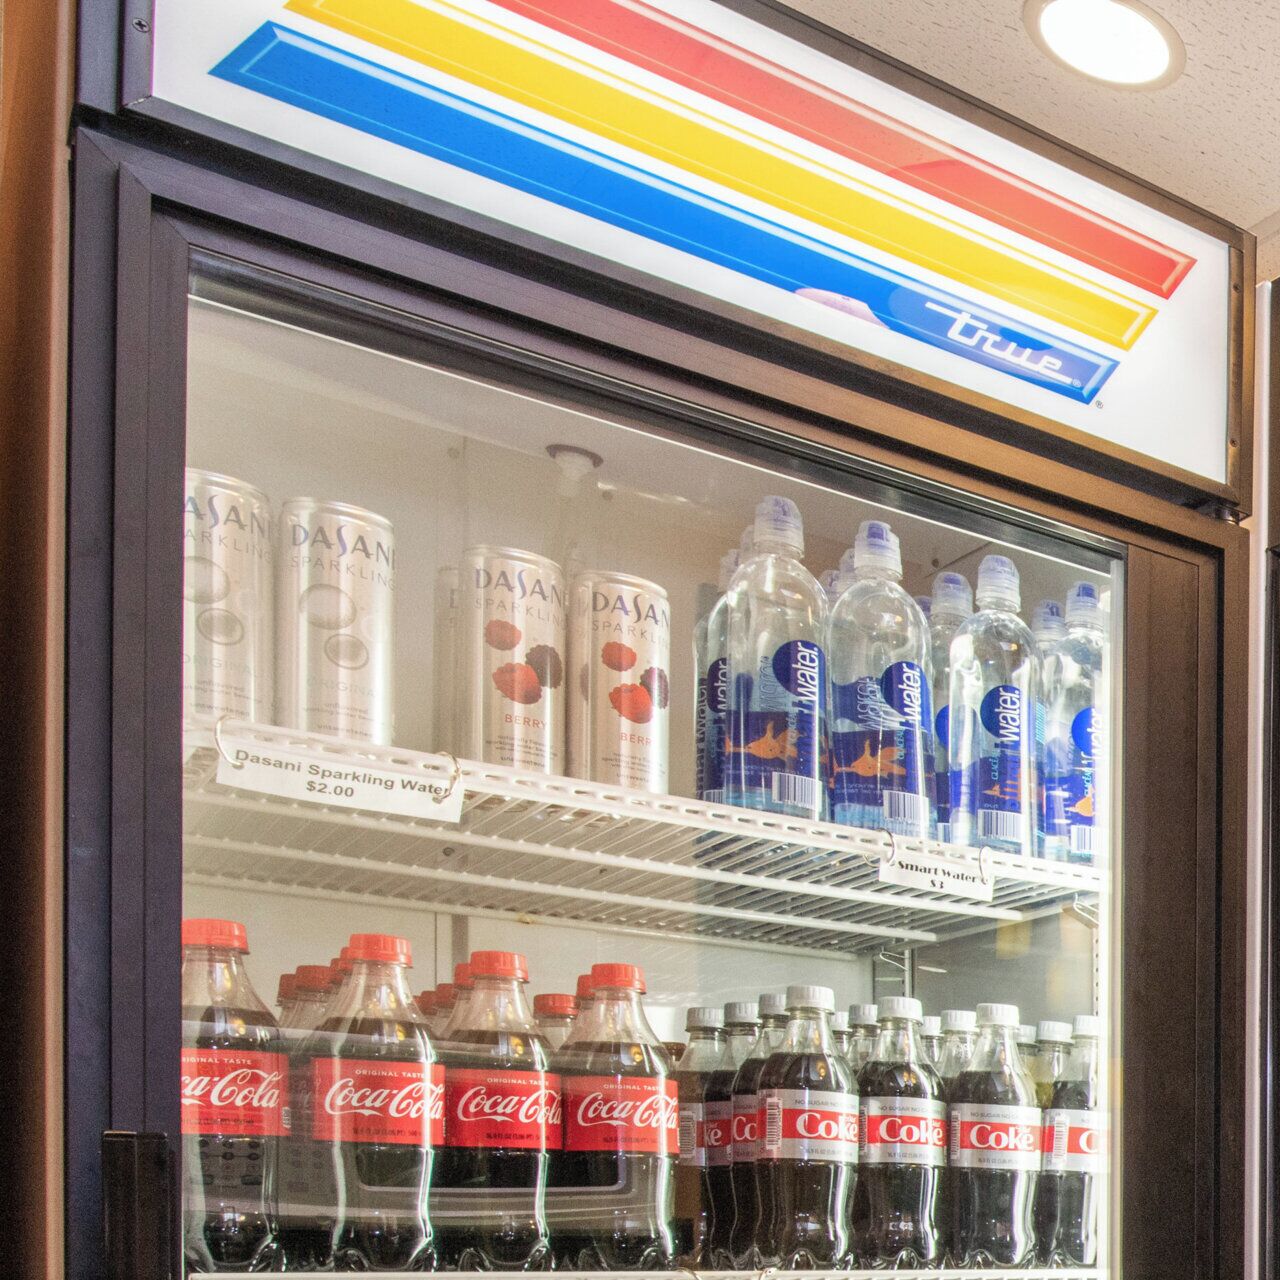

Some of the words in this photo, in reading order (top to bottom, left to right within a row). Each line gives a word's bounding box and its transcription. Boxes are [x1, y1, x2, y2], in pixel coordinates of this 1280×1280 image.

[291, 523, 396, 570] DASANI
[291, 555, 396, 591] SPARKLING
[504, 713, 549, 729] BERRY
[997, 687, 1021, 744] water
[235, 749, 301, 773] Dasani
[308, 763, 395, 790] Sparkling
[401, 779, 450, 796] Water
[306, 780, 355, 798] $2.00
[898, 860, 938, 876] Smart
[942, 869, 977, 883] Water
[324, 1078, 446, 1120] Coca-Cola
[457, 1086, 562, 1125] Coca-Cola
[577, 1091, 679, 1130] Coca-Cola
[796, 1112, 859, 1142] Coke
[879, 1117, 944, 1146] Coke
[969, 1124, 1034, 1150] Coke
